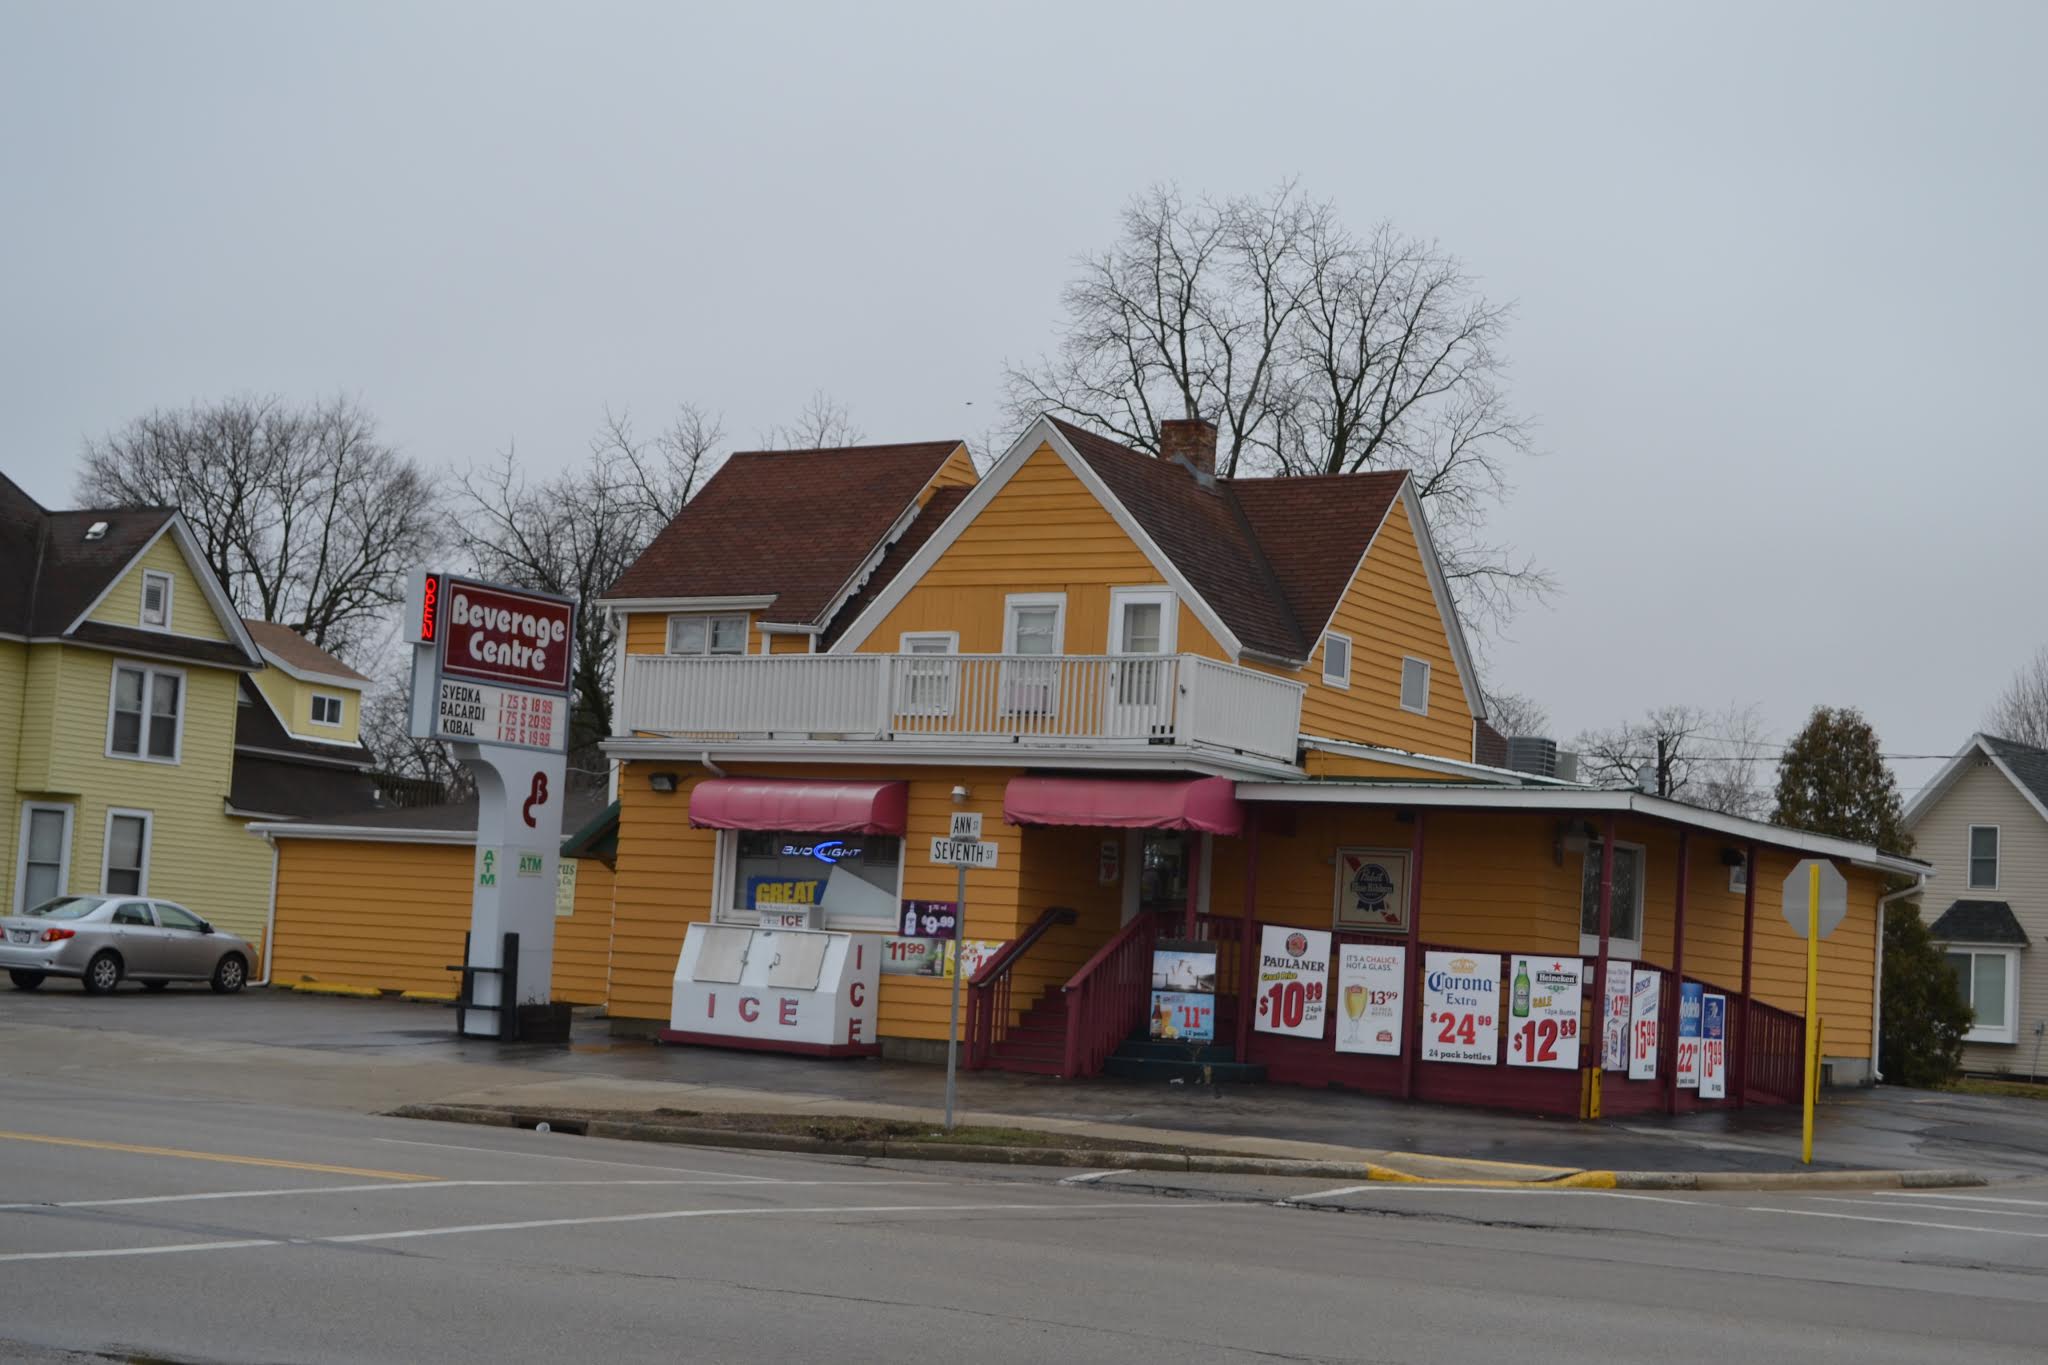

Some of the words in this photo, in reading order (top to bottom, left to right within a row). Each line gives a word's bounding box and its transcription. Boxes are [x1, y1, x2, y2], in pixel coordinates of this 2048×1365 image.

[452, 594, 565, 648] Beverage
[469, 632, 547, 672] Centre
[442, 685, 481, 703] SVEDKA
[440, 701, 485, 721] BACARDI
[952, 816, 973, 834] ANN
[972, 820, 979, 831] ST
[781, 845, 813, 855] BUD
[819, 847, 862, 858] LIGHT
[934, 841, 984, 862] SEVENTH
[986, 851, 993, 860] ST
[480, 850, 496, 885] ATM
[519, 857, 542, 871] ATM
[755, 880, 818, 904] GREAT
[781, 914, 804, 927] ICE
[1263, 955, 1325, 972] PAULANER
[1428, 971, 1492, 995] Corona
[1540, 973, 1575, 984] Heineken
[848, 944, 865, 1045] ICE
[1446, 993, 1477, 1006] Extra
[1532, 996, 1552, 1008] SALE
[707, 993, 799, 1026] ICE
[1429, 1049, 1438, 1057] 24
[1441, 1050, 1461, 1059] pack
[1463, 1051, 1491, 1061] bottles
